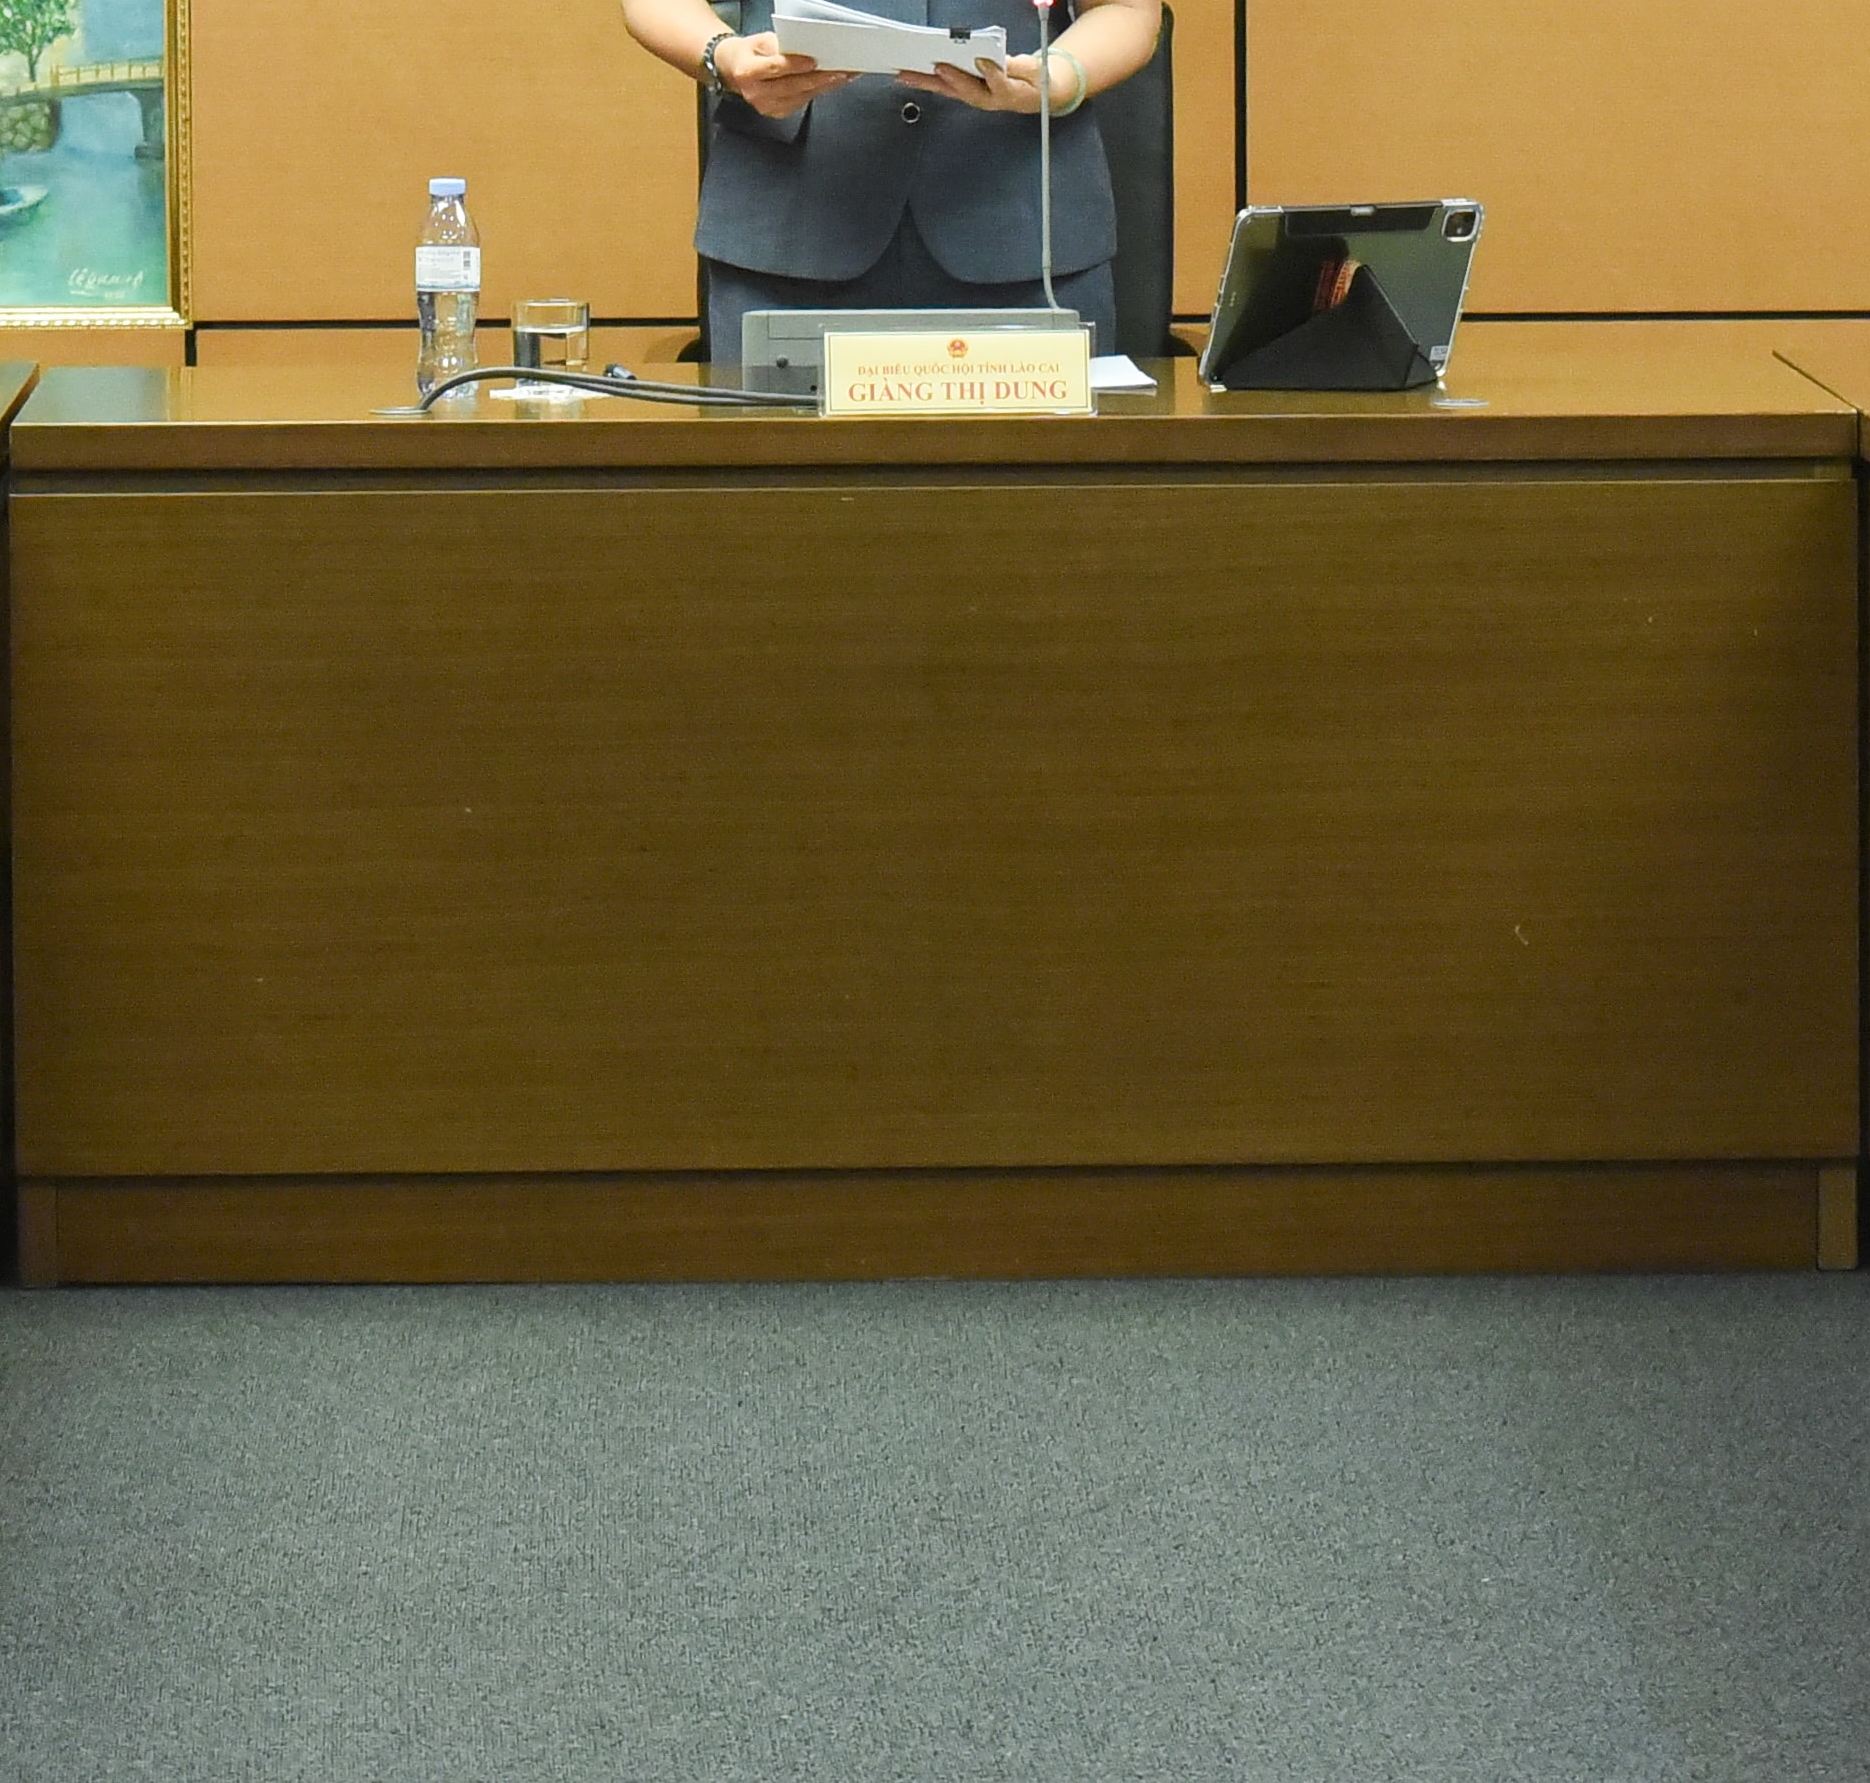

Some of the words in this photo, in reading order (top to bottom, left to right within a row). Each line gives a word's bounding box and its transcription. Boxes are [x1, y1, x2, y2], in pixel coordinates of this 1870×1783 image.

[858, 365, 879, 378] ĐẠI
[913, 362, 950, 377] QUỐC
[952, 363, 975, 376] HỘI
[1010, 361, 1036, 374] LÀO
[1038, 363, 1060, 374] CAI
[848, 377, 934, 402] GIÀNG
[940, 381, 985, 405] THỊ
[994, 379, 1068, 400] DUNG
